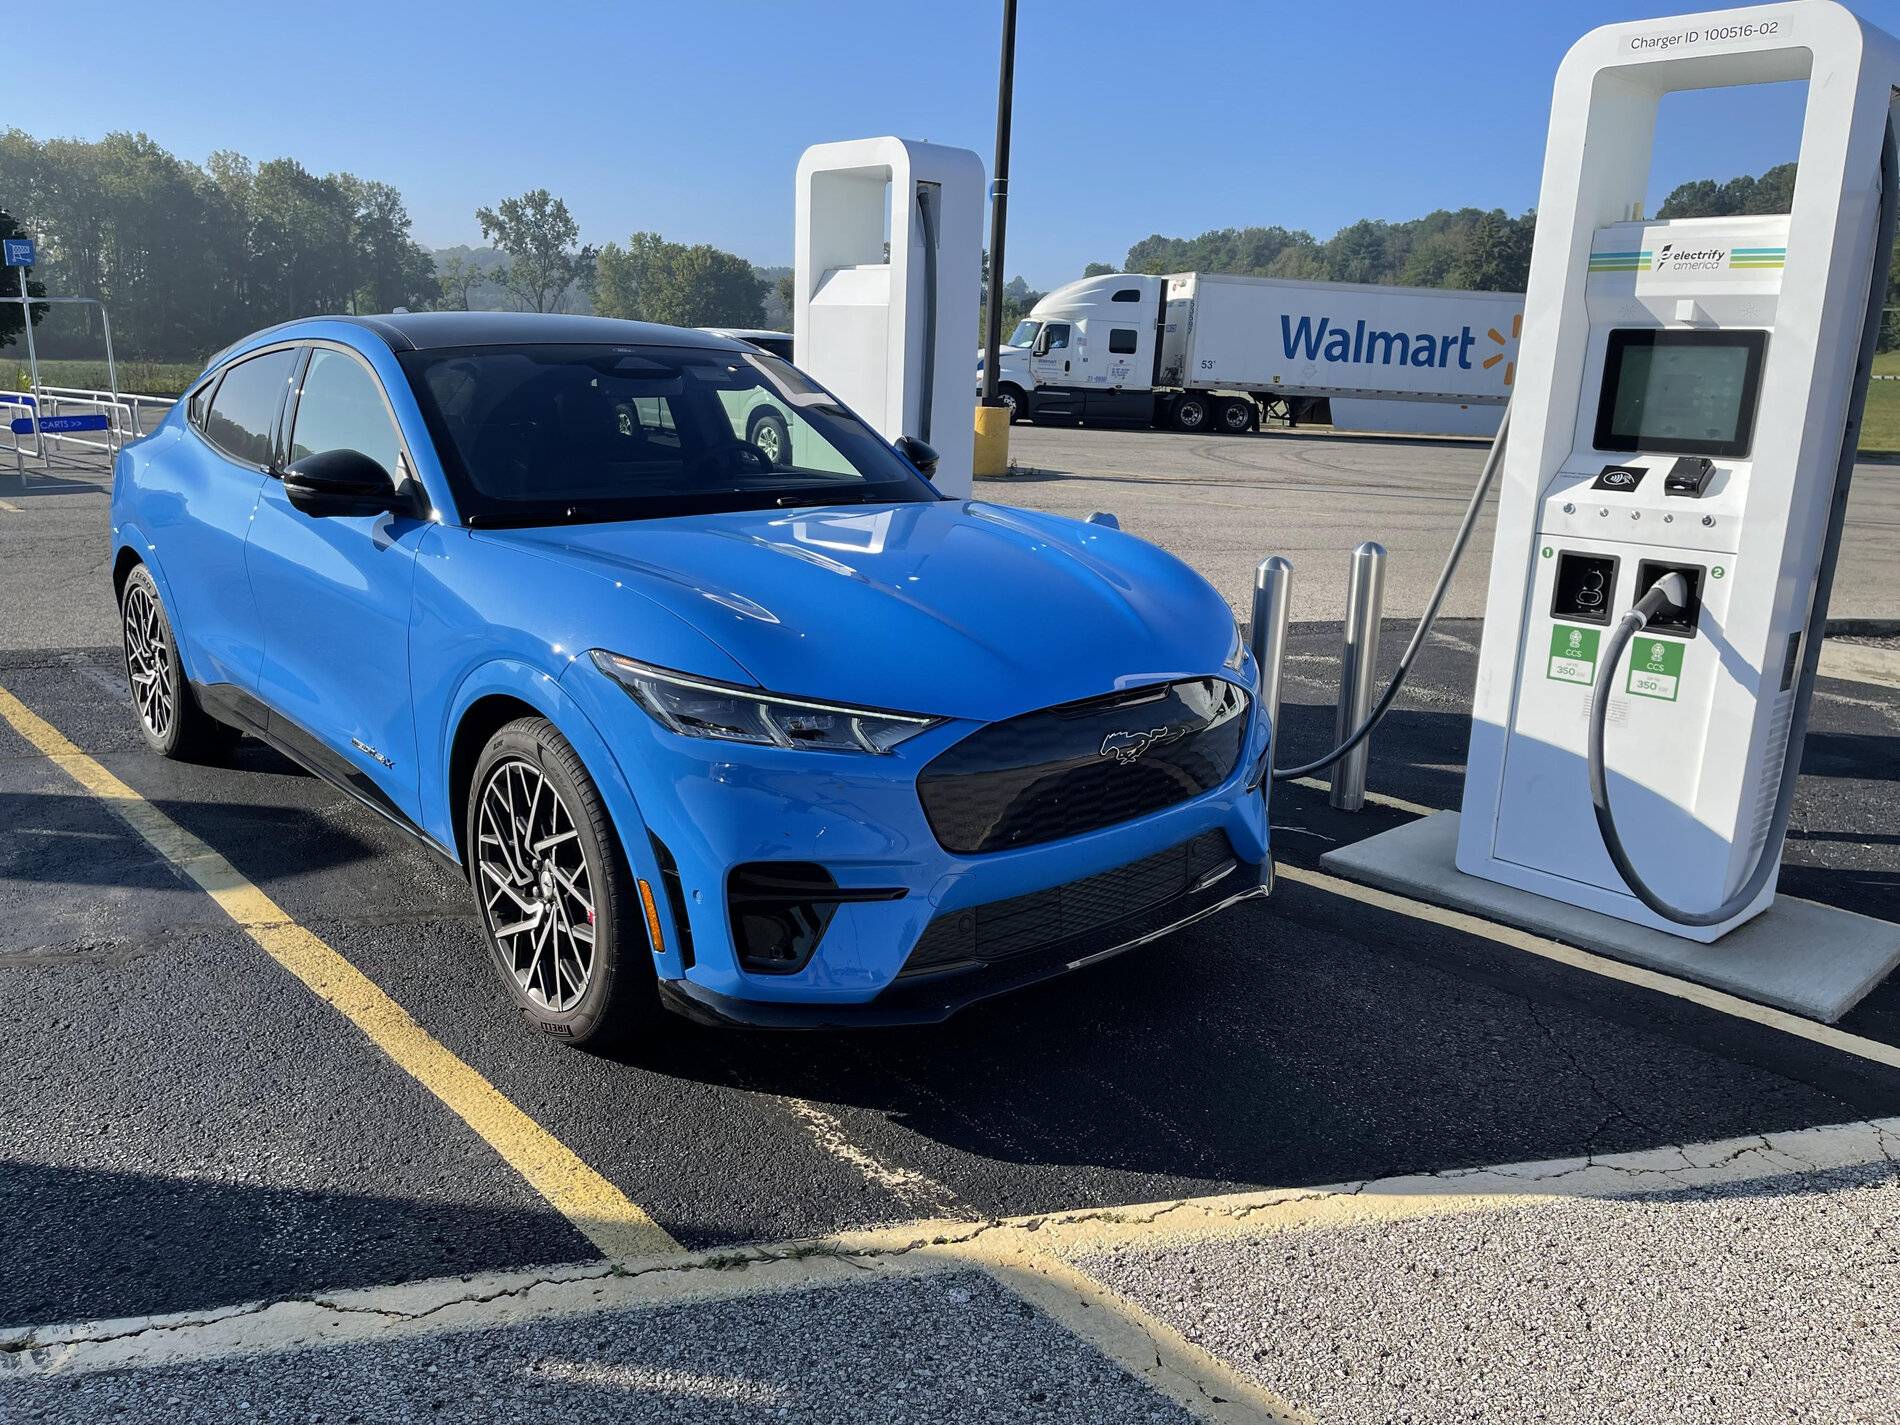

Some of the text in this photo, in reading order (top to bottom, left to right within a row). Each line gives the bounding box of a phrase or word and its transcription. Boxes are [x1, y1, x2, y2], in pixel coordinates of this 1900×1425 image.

[1631, 21, 1779, 49] Charger ID 100516-02
[1673, 249, 1725, 262] electrify
[1673, 261, 1719, 271] america
[1280, 314, 1476, 370] Walmart
[40, 421, 69, 430] CARTS
[1565, 649, 1582, 658] CCS
[1556, 665, 1576, 676] 350
[1646, 662, 1665, 672] CCS
[1637, 680, 1657, 690] 350
